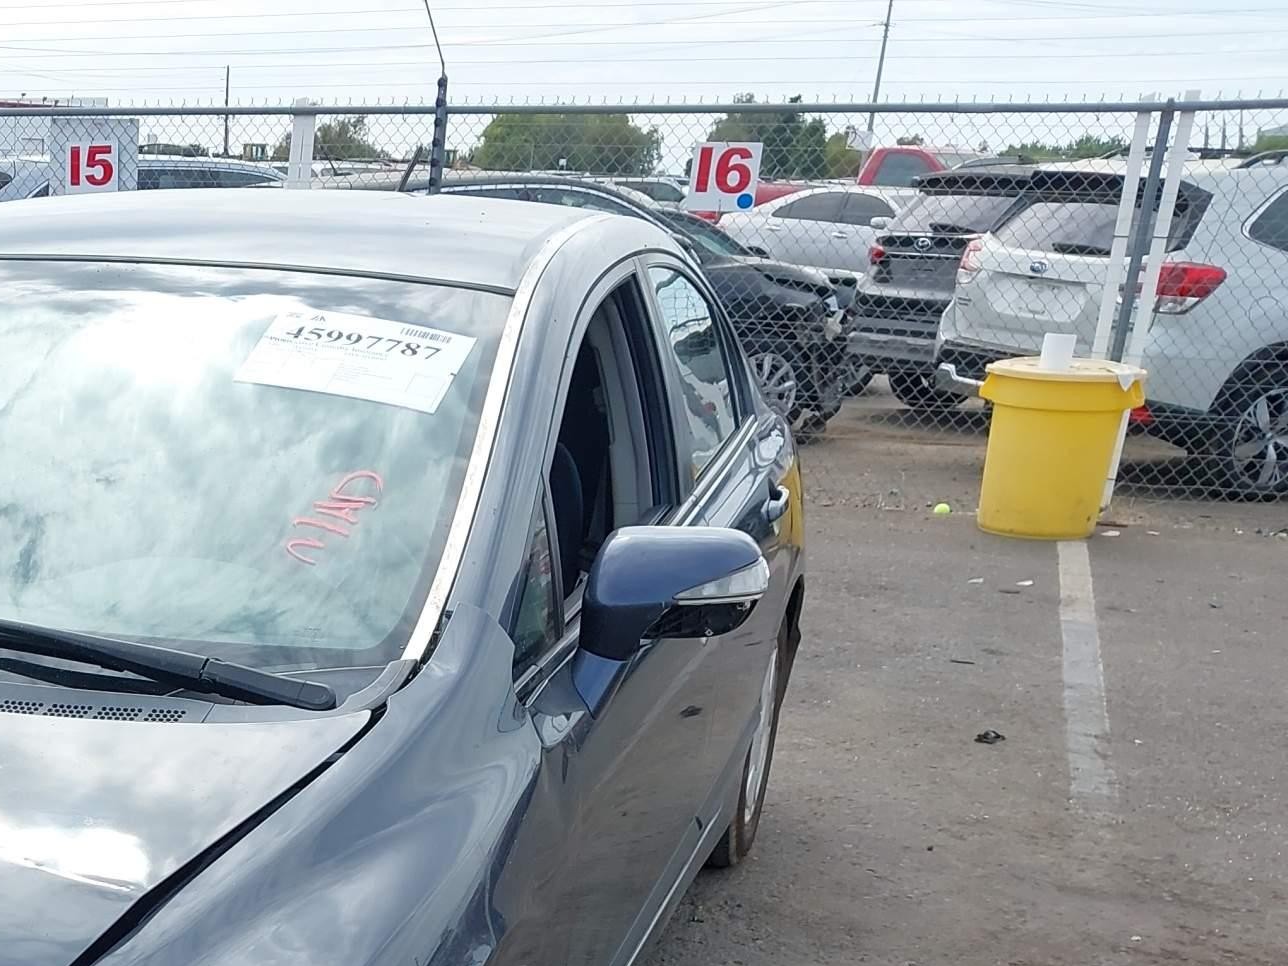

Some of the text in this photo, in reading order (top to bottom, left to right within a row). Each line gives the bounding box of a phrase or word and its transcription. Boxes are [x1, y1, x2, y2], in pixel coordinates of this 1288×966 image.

[70, 145, 114, 186] 15
[695, 147, 753, 194] 16
[286, 325, 442, 360] 45997787
